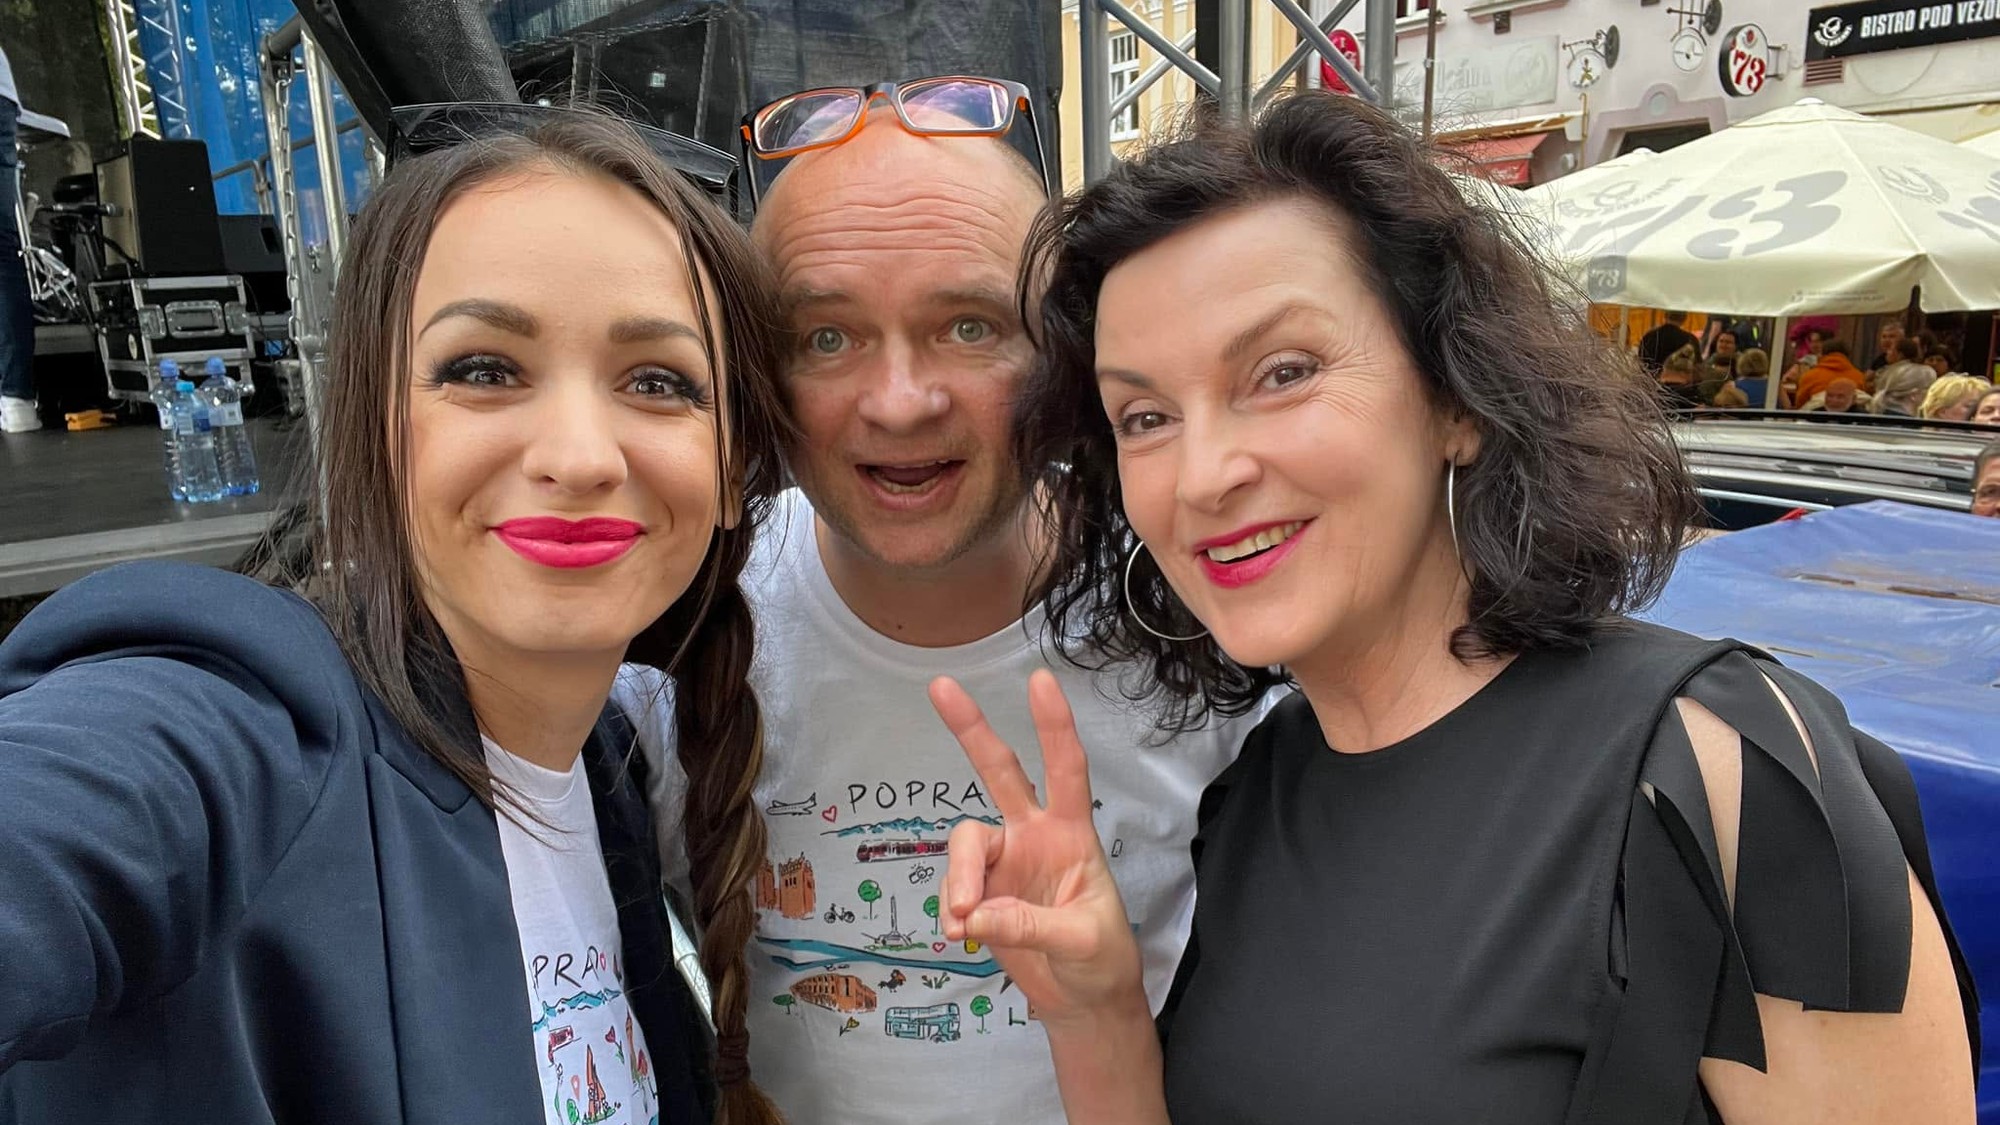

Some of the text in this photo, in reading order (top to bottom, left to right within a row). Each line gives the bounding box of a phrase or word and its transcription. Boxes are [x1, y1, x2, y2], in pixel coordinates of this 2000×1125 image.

[1860, 9, 1916, 38] BISTRO
[1918, 4, 1953, 30] POD
[847, 780, 988, 813] POPRA
